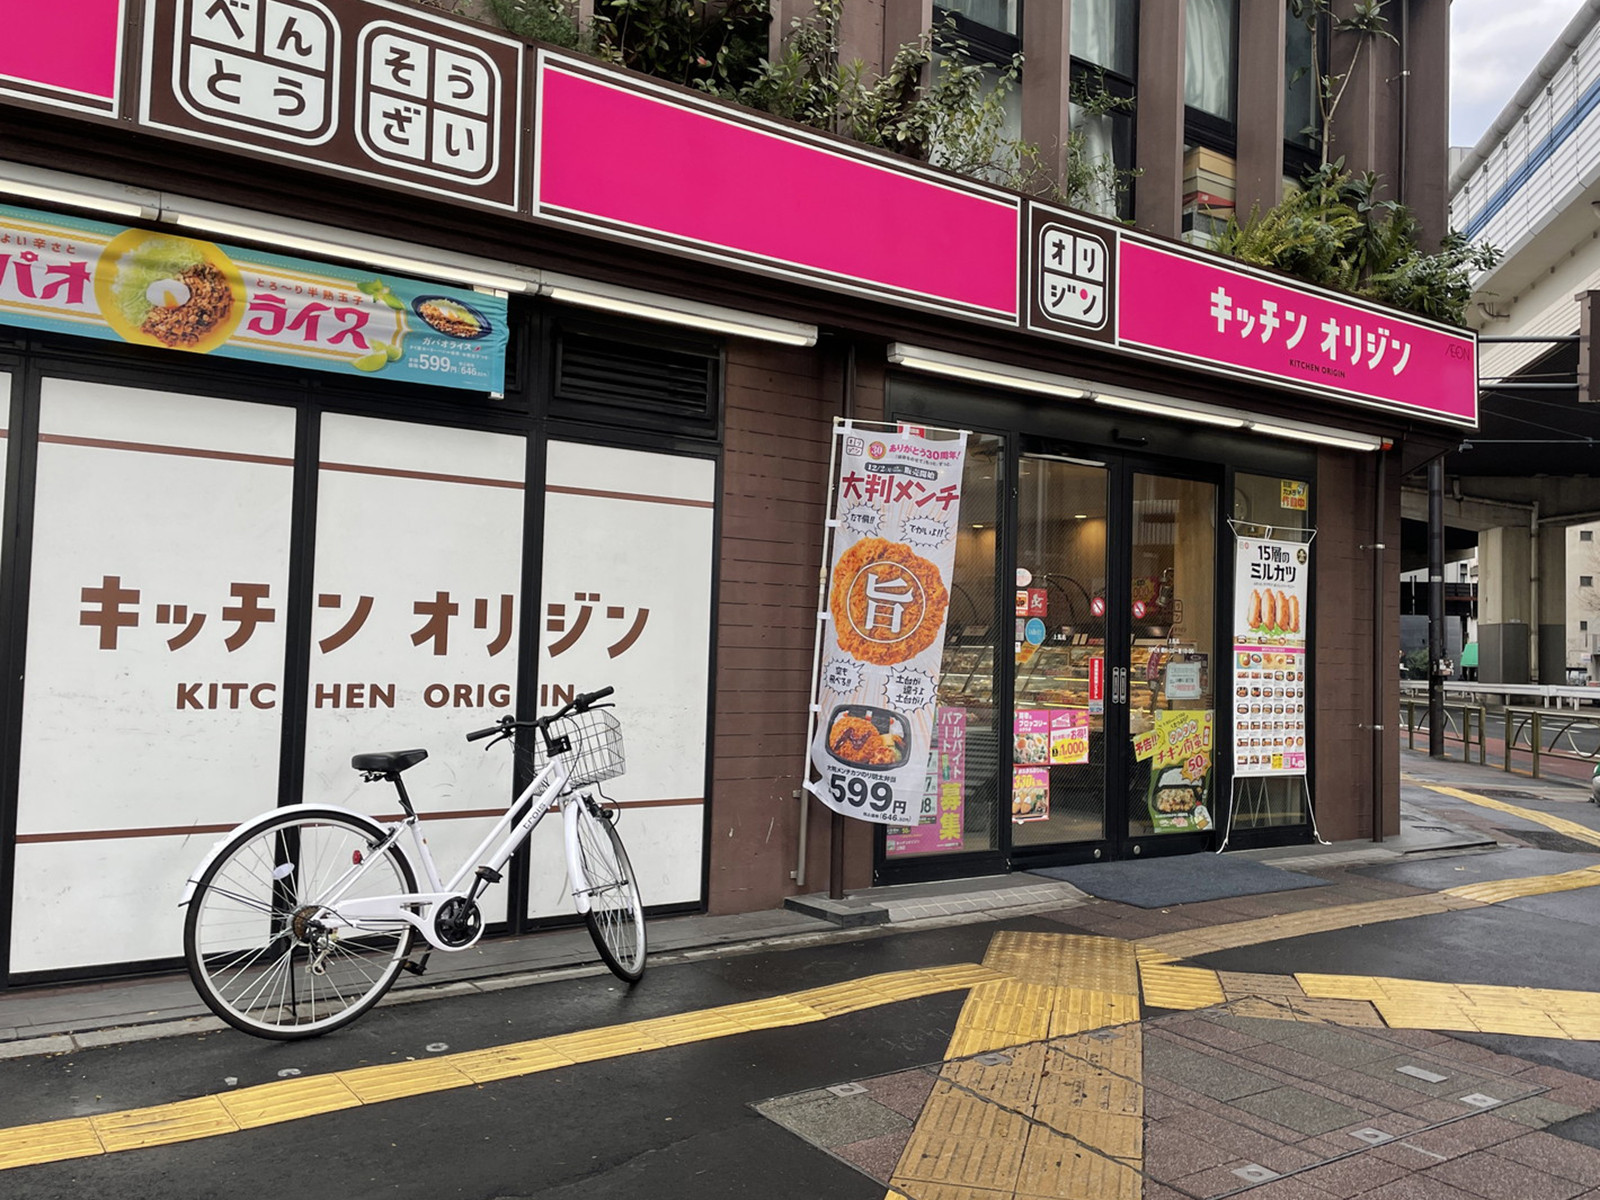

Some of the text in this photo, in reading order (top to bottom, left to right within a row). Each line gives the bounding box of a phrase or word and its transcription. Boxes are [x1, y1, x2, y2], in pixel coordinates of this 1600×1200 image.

[205, 0, 312, 57] べん
[207, 58, 306, 117] とう
[384, 46, 474, 99] そう
[382, 106, 474, 157] ざい
[1050, 238, 1096, 273] オリ
[247, 293, 370, 350] ライス
[1050, 283, 1097, 317] ジン
[422, 337, 472, 351] ガパオライス
[1210, 286, 1412, 377] キッチン オリジン
[1288, 358, 1346, 379] KITCHEN ORIGIN
[842, 471, 960, 511] 大判メンチ
[1250, 563, 1297, 583] ミルカツ
[1257, 545, 1290, 563] 15層の
[79, 575, 651, 660] キッチン オリジン
[865, 572, 914, 633] 旨
[176, 682, 575, 711] KITCHEN ORIGIN
[895, 675, 921, 685] 土台が
[952, 712, 963, 779] アルバイト
